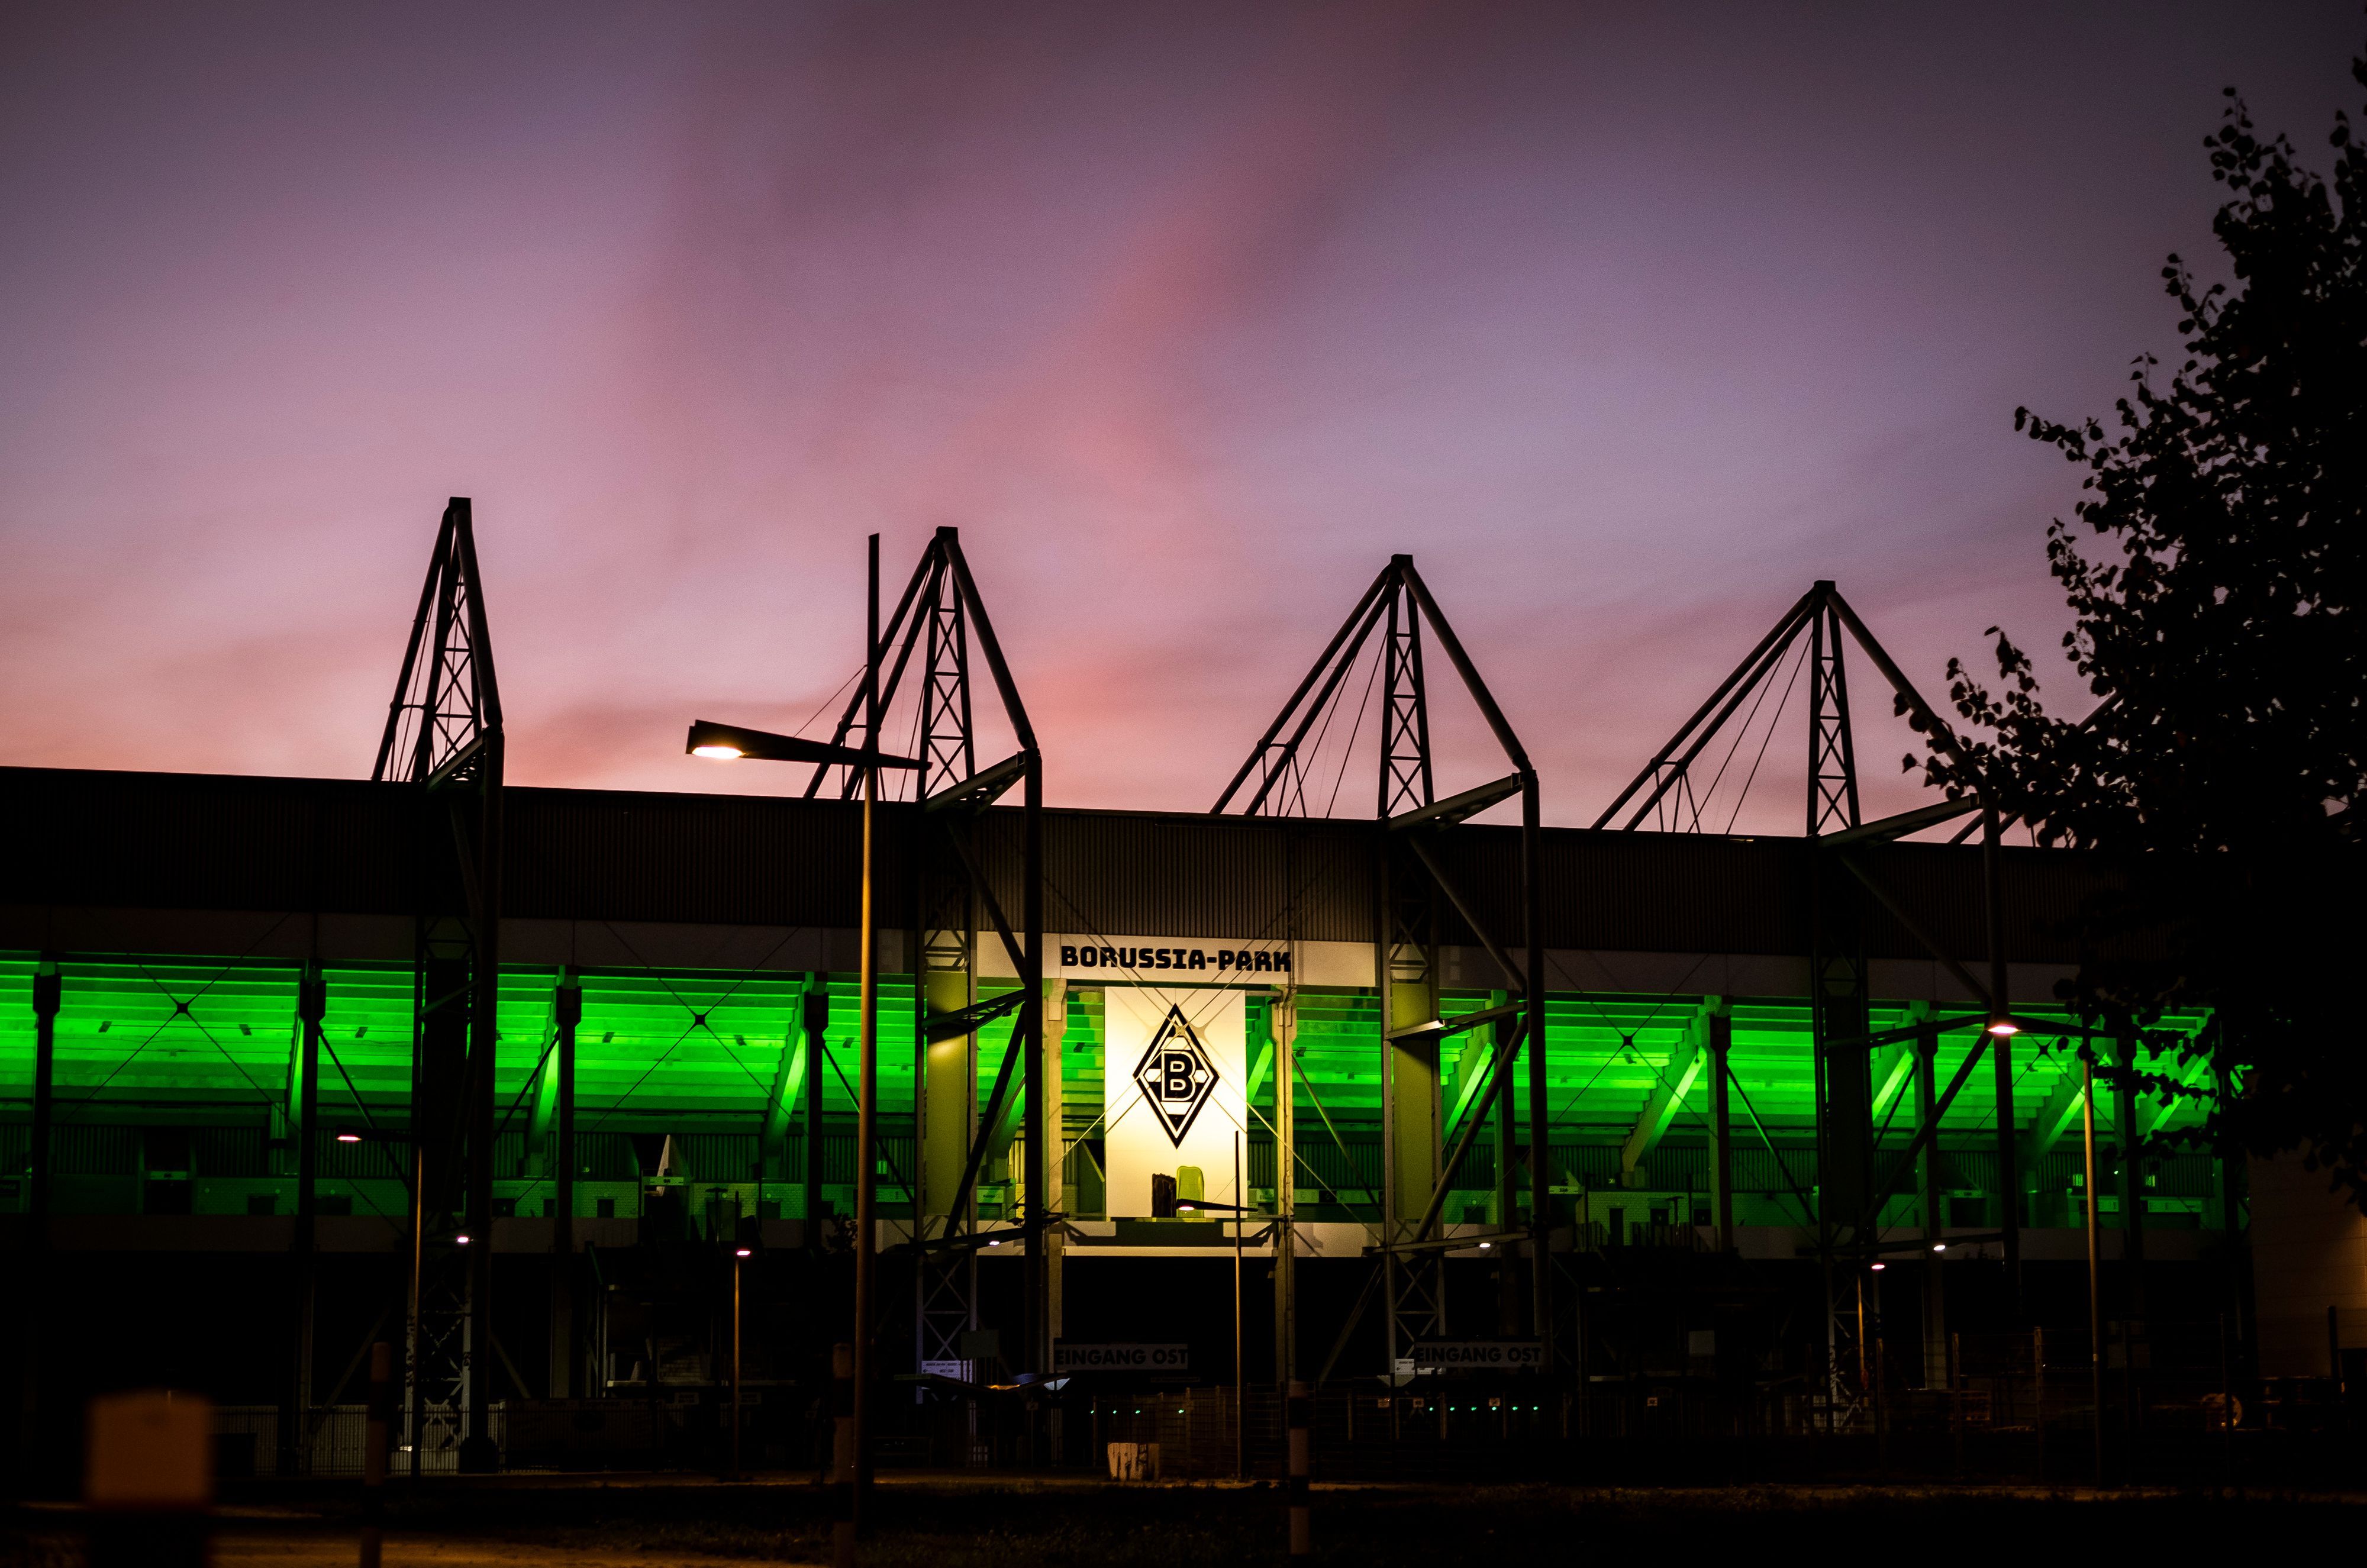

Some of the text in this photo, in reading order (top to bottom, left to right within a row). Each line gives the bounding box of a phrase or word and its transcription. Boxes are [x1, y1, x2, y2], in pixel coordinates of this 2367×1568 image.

[1062, 946, 1291, 972] BORUSSIA-PARK
[1161, 1051, 1196, 1101] B
[1055, 1349, 1188, 1364] EINGANG OST
[1416, 1347, 1541, 1362] EINGANG OST
